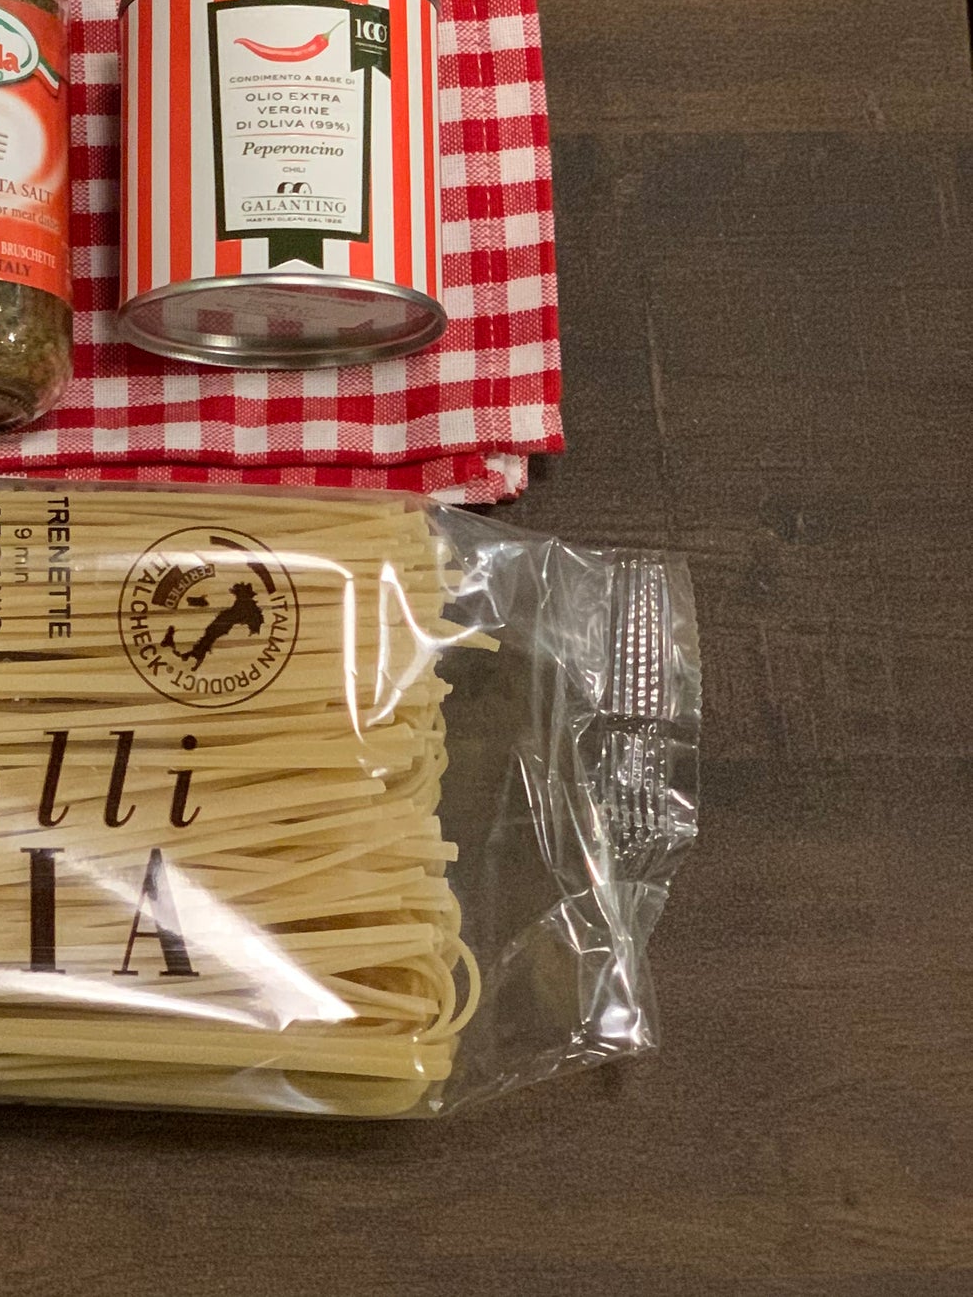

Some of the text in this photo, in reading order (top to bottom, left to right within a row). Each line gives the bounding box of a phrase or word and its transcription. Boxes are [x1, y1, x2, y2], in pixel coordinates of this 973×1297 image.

[229, 74, 356, 86] CONDIMENTO A BASE DI
[245, 92, 341, 104] OLIO EXTRA
[257, 105, 330, 116] VERGINE
[236, 119, 351, 132] DI OLIVA (99%)
[241, 141, 345, 159] Peperoncino
[21, 183, 53, 205] SALT
[11, 208, 36, 222] meat
[241, 200, 347, 214] GALANTINO
[1, 241, 57, 269] BRUSCHETTE
[14, 527, 33, 584] 9 min
[47, 496, 72, 639] TRENETTE
[170, 594, 290, 695] ITALIAN PRODUCT
